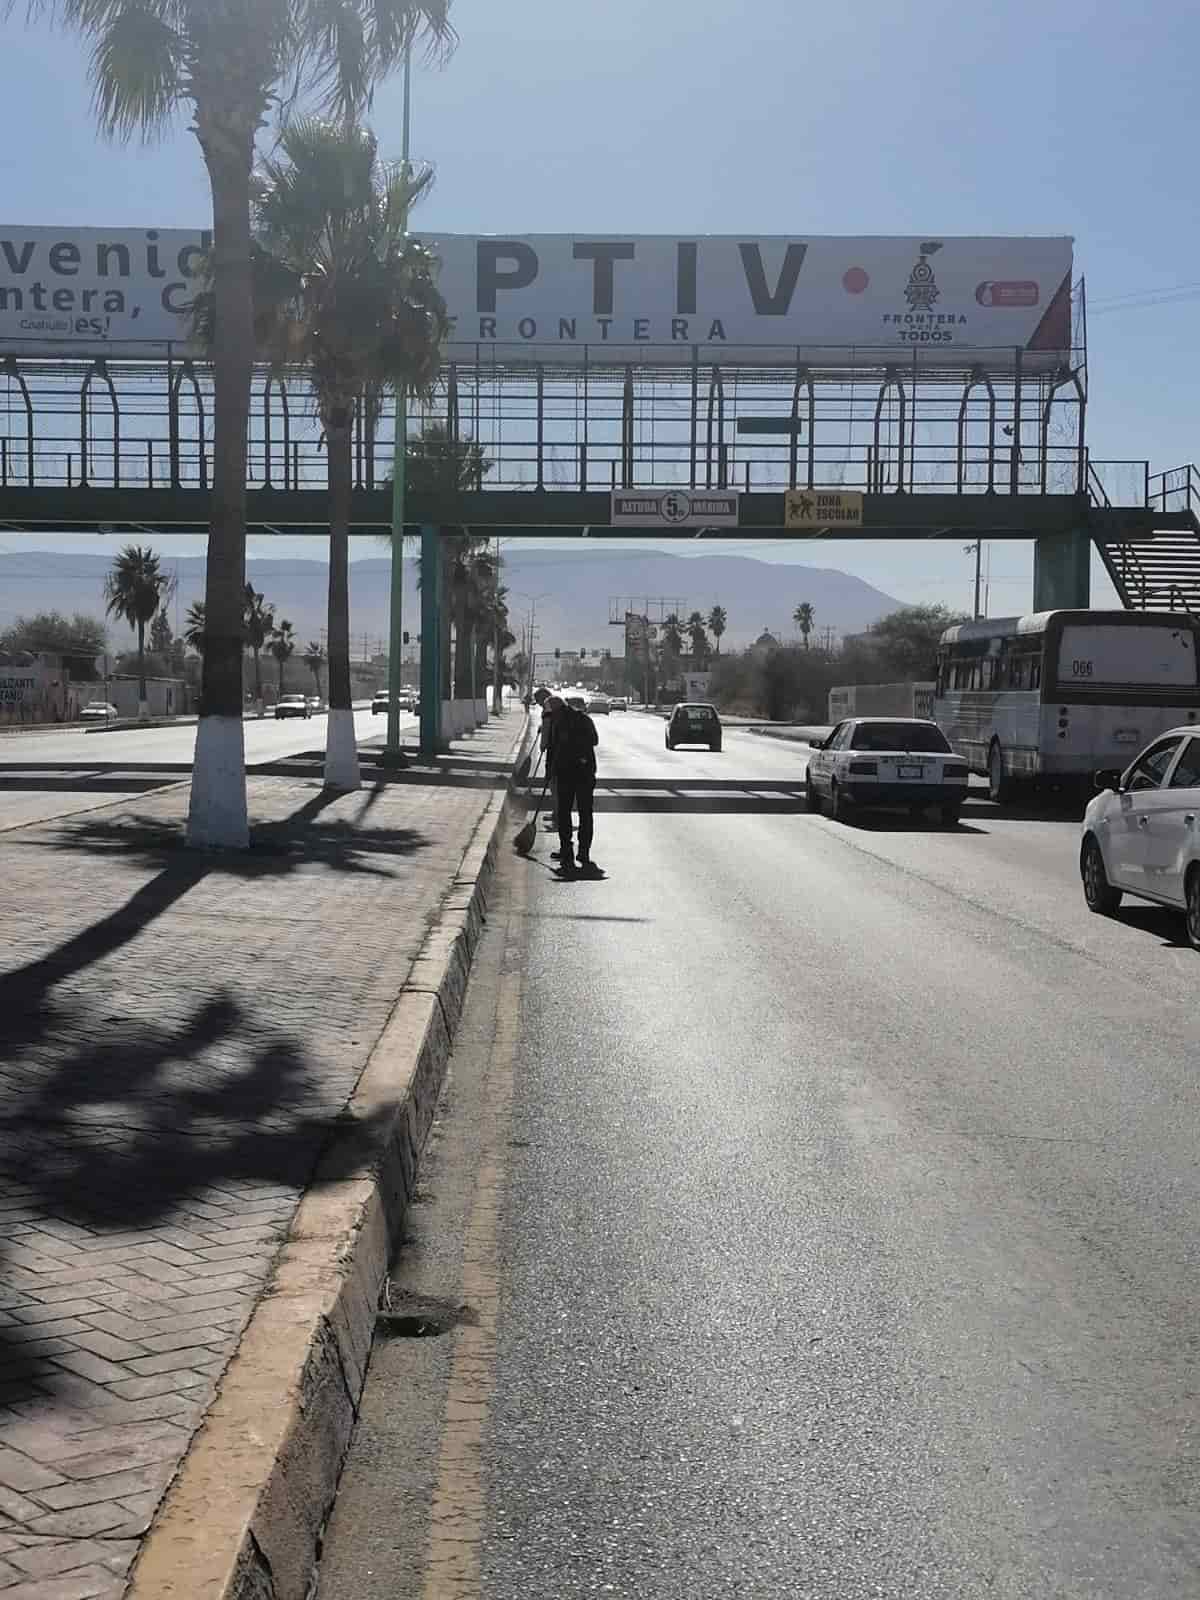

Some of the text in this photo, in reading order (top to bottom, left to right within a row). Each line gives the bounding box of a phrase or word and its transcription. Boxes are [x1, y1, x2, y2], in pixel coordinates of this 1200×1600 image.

[883, 314, 967, 324] FRONTERA
[899, 331, 952, 341] TODOS
[817, 496, 842, 506] ZONA
[816, 509, 859, 521] ESCOLAR
